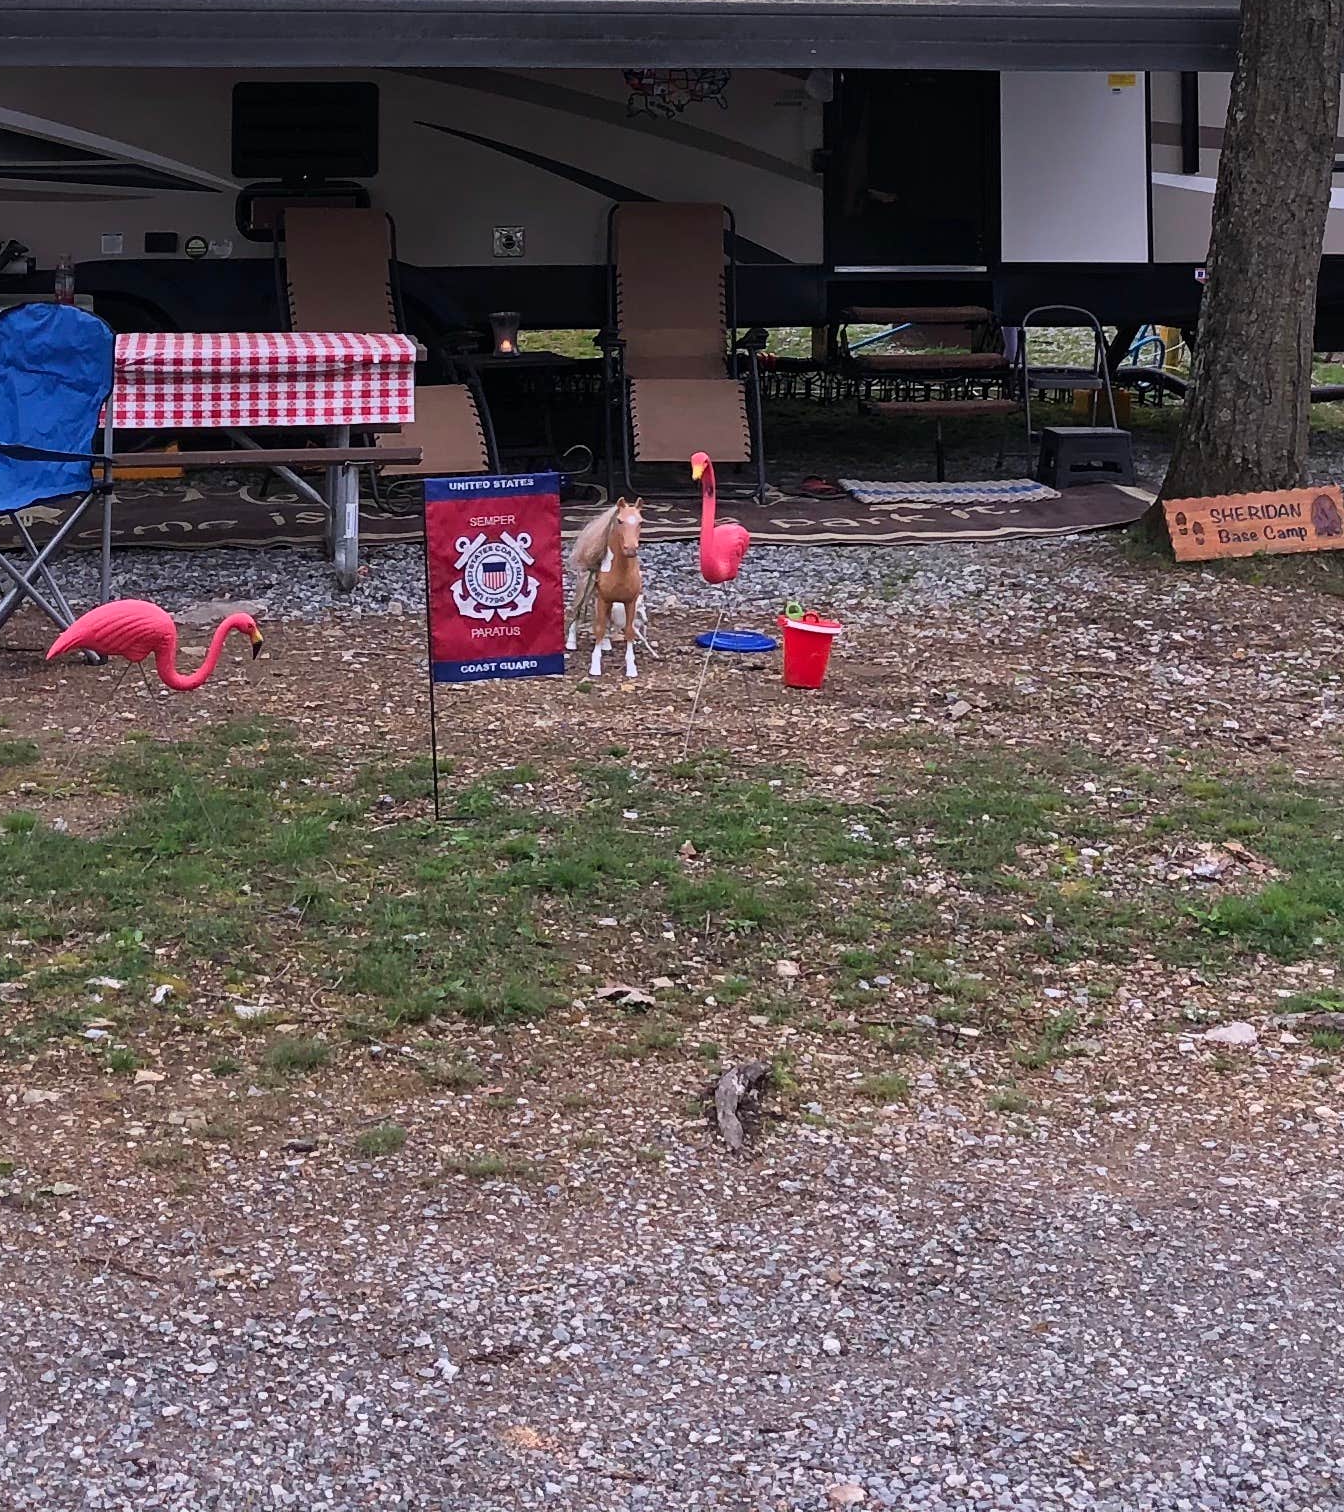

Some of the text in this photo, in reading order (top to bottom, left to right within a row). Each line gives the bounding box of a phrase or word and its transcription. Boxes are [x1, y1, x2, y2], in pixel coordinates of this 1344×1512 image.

[448, 479, 535, 491] UNITED STATES
[1209, 503, 1302, 524] SHERIDAN
[469, 515, 517, 527] SEMPER
[768, 512, 937, 530] park
[1217, 525, 1308, 544] Base Camp
[471, 626, 521, 639] PARATUS
[460, 660, 538, 673] COAST GUARD
